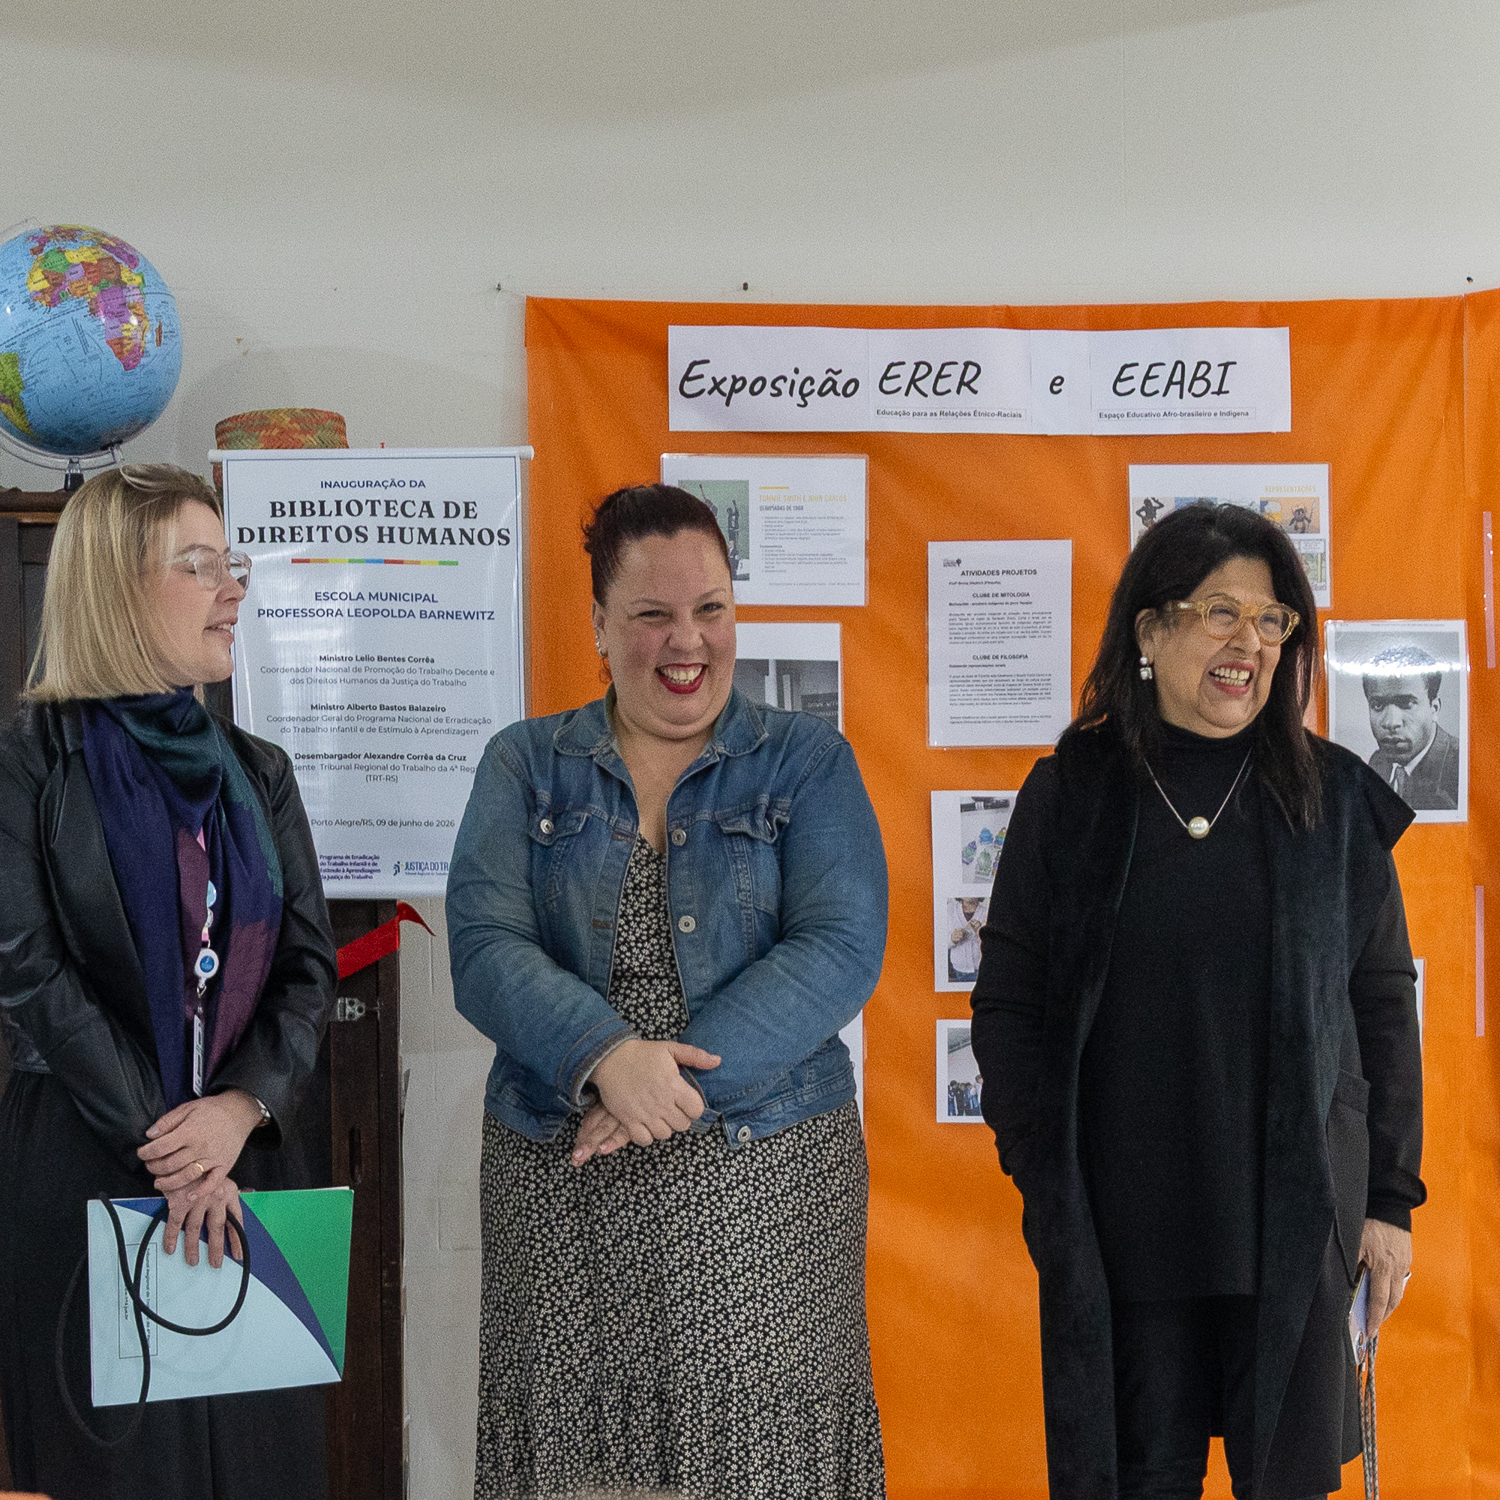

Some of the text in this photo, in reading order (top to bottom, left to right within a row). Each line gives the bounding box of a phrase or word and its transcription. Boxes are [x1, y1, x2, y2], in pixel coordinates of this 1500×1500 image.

[679, 359, 1236, 407] Exposição ERER e EEABI
[876, 409, 911, 418] Educação
[1099, 412, 1125, 421] Espaço
[1163, 410, 1211, 418] Afro-brasileiro
[320, 478, 426, 490] INAUGURAÇÃO DA
[270, 500, 478, 520] BIBLIOTECA DE
[238, 525, 511, 546] DIREITOS HUMANOS
[961, 569, 1000, 577] ATIVIDADES
[315, 592, 439, 603] ESCOLA MUNICIPAL
[258, 608, 495, 621] PROFESSORA LEOPOLDA BARNEWITZ
[408, 655, 435, 664] Corrêa
[260, 666, 313, 674] Coordenador
[316, 666, 350, 674] Nacional
[352, 666, 363, 674] de
[364, 667, 405, 676] Promoção
[407, 667, 418, 675] do
[419, 667, 453, 676] Trabalho
[454, 668, 489, 676] Decente
[289, 677, 305, 685] dos
[306, 677, 338, 685] Direitos
[391, 678, 419, 687] Justiça
[420, 678, 431, 686] do
[433, 678, 467, 687] Trabalho
[379, 704, 407, 712] Bastos
[409, 704, 446, 713] Balazeiro
[266, 715, 319, 723] Coordenador
[357, 715, 396, 724] Programa
[398, 716, 432, 724] Nacional
[433, 716, 444, 724] de
[446, 716, 492, 726] Erradicação
[280, 726, 291, 734] do
[293, 726, 328, 734] Trabalho
[366, 726, 377, 734] de
[378, 726, 412, 734] Estímulo
[414, 726, 419, 734] à
[421, 727, 479, 736] Aprendizagem
[295, 753, 362, 761] Desembargador
[363, 753, 405, 761] Alexandre
[407, 753, 434, 761] Corrêa
[448, 754, 467, 762] Cruz
[354, 764, 389, 773] Regional
[402, 764, 436, 772] Trabalho
[365, 775, 399, 784] (TRT-RS)
[311, 819, 333, 827] Porto
[334, 819, 375, 828] Alegre/RS,
[388, 819, 398, 827] de
[399, 819, 423, 829] junho
[405, 862, 430, 872] JUSTIÇA
[430, 862, 439, 871] DO
